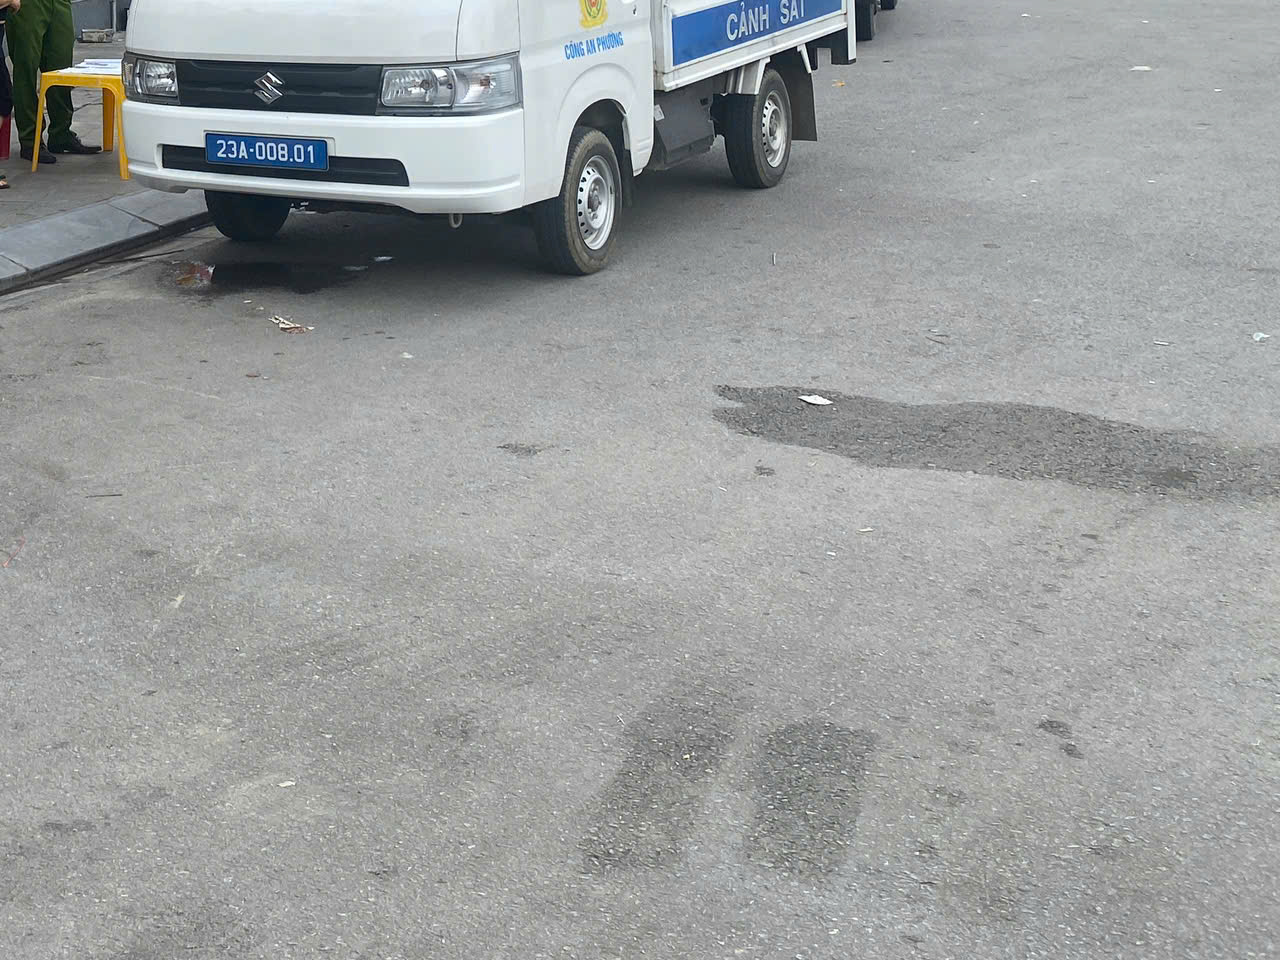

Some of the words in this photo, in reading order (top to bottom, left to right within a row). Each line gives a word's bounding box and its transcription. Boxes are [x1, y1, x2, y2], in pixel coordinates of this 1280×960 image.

[726, 0, 769, 41] CẢNH
[564, 42, 585, 60] CÔNG
[585, 39, 596, 56] AN
[216, 139, 315, 164] 23A-008.01
